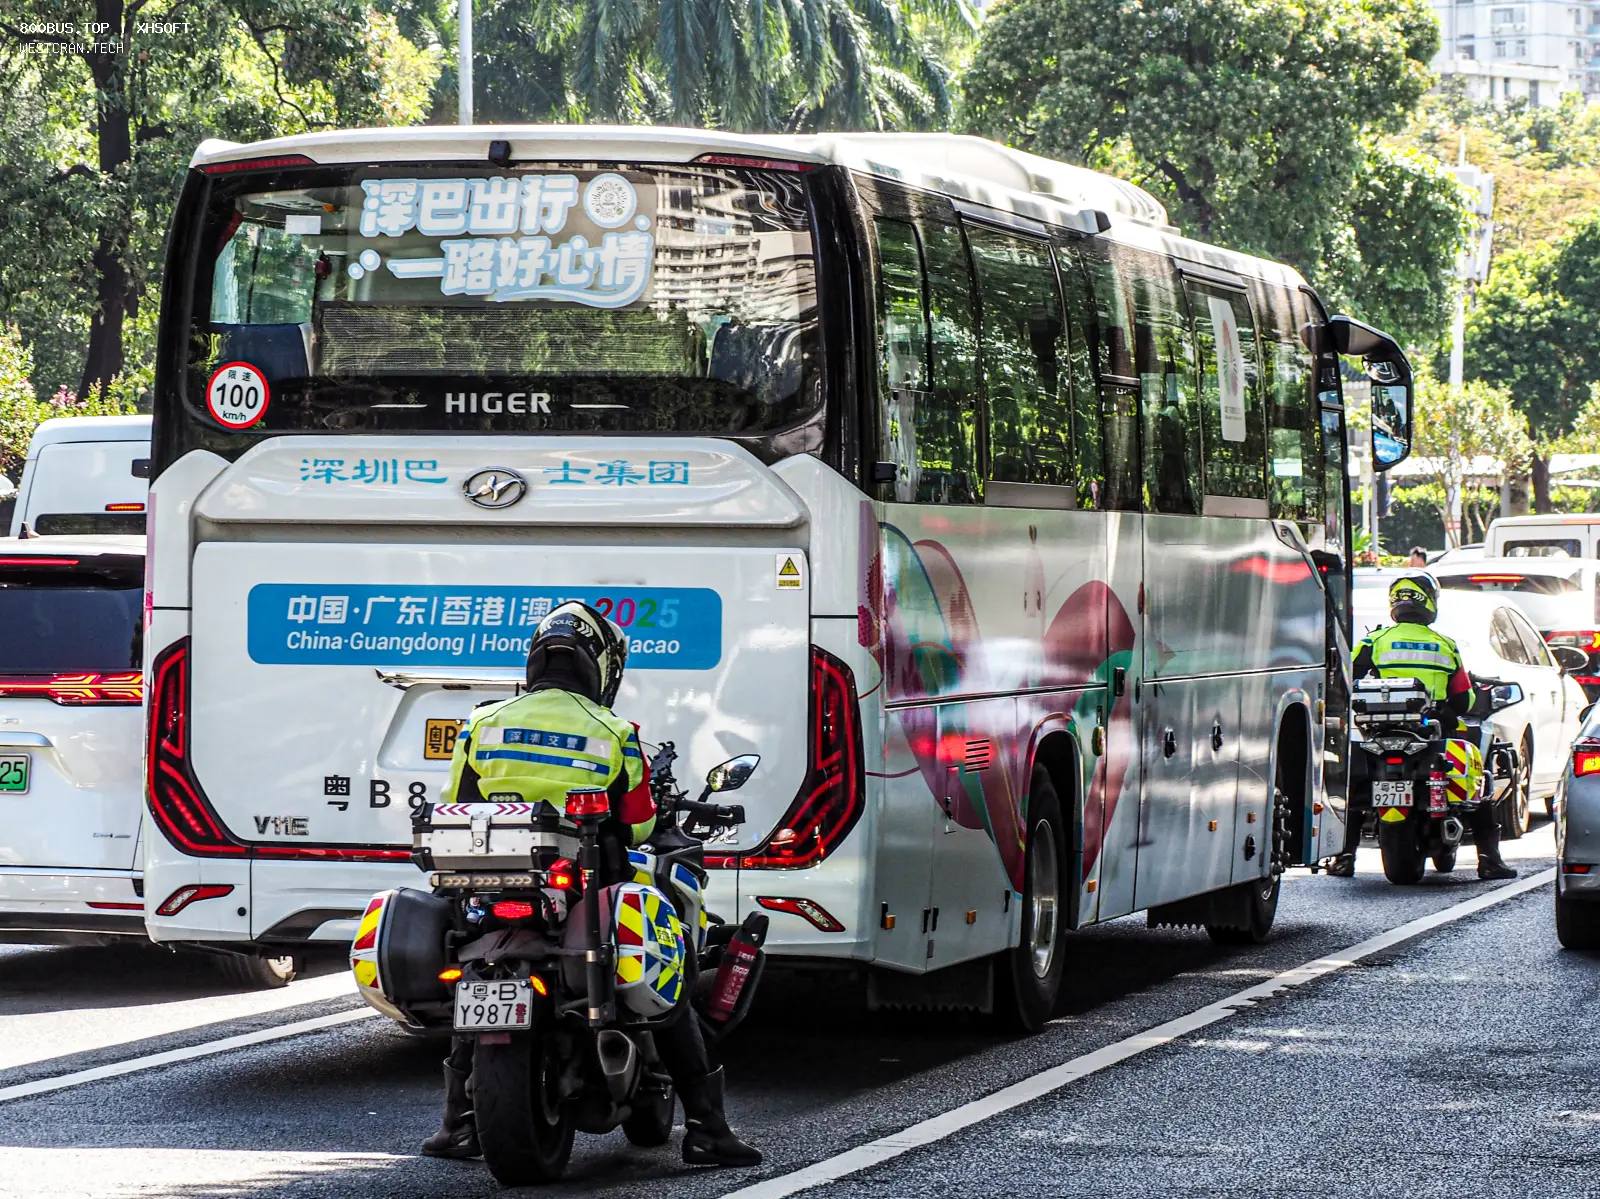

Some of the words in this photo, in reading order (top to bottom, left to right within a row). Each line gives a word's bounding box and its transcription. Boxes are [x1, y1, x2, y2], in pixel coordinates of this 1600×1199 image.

[361, 176, 578, 237] 深巴出行
[387, 234, 653, 298] 一路好心情
[216, 383, 258, 410] 100
[445, 392, 551, 413] HIGER
[222, 410, 247, 421] km/h
[552, 619, 579, 628] POLICE
[595, 597, 680, 628] 2025
[481, 633, 532, 656] Hong
[627, 635, 681, 654] acao
[428, 725, 458, 754] 粤B
[0, 761, 24, 785] 25
[253, 815, 310, 836] V11E
